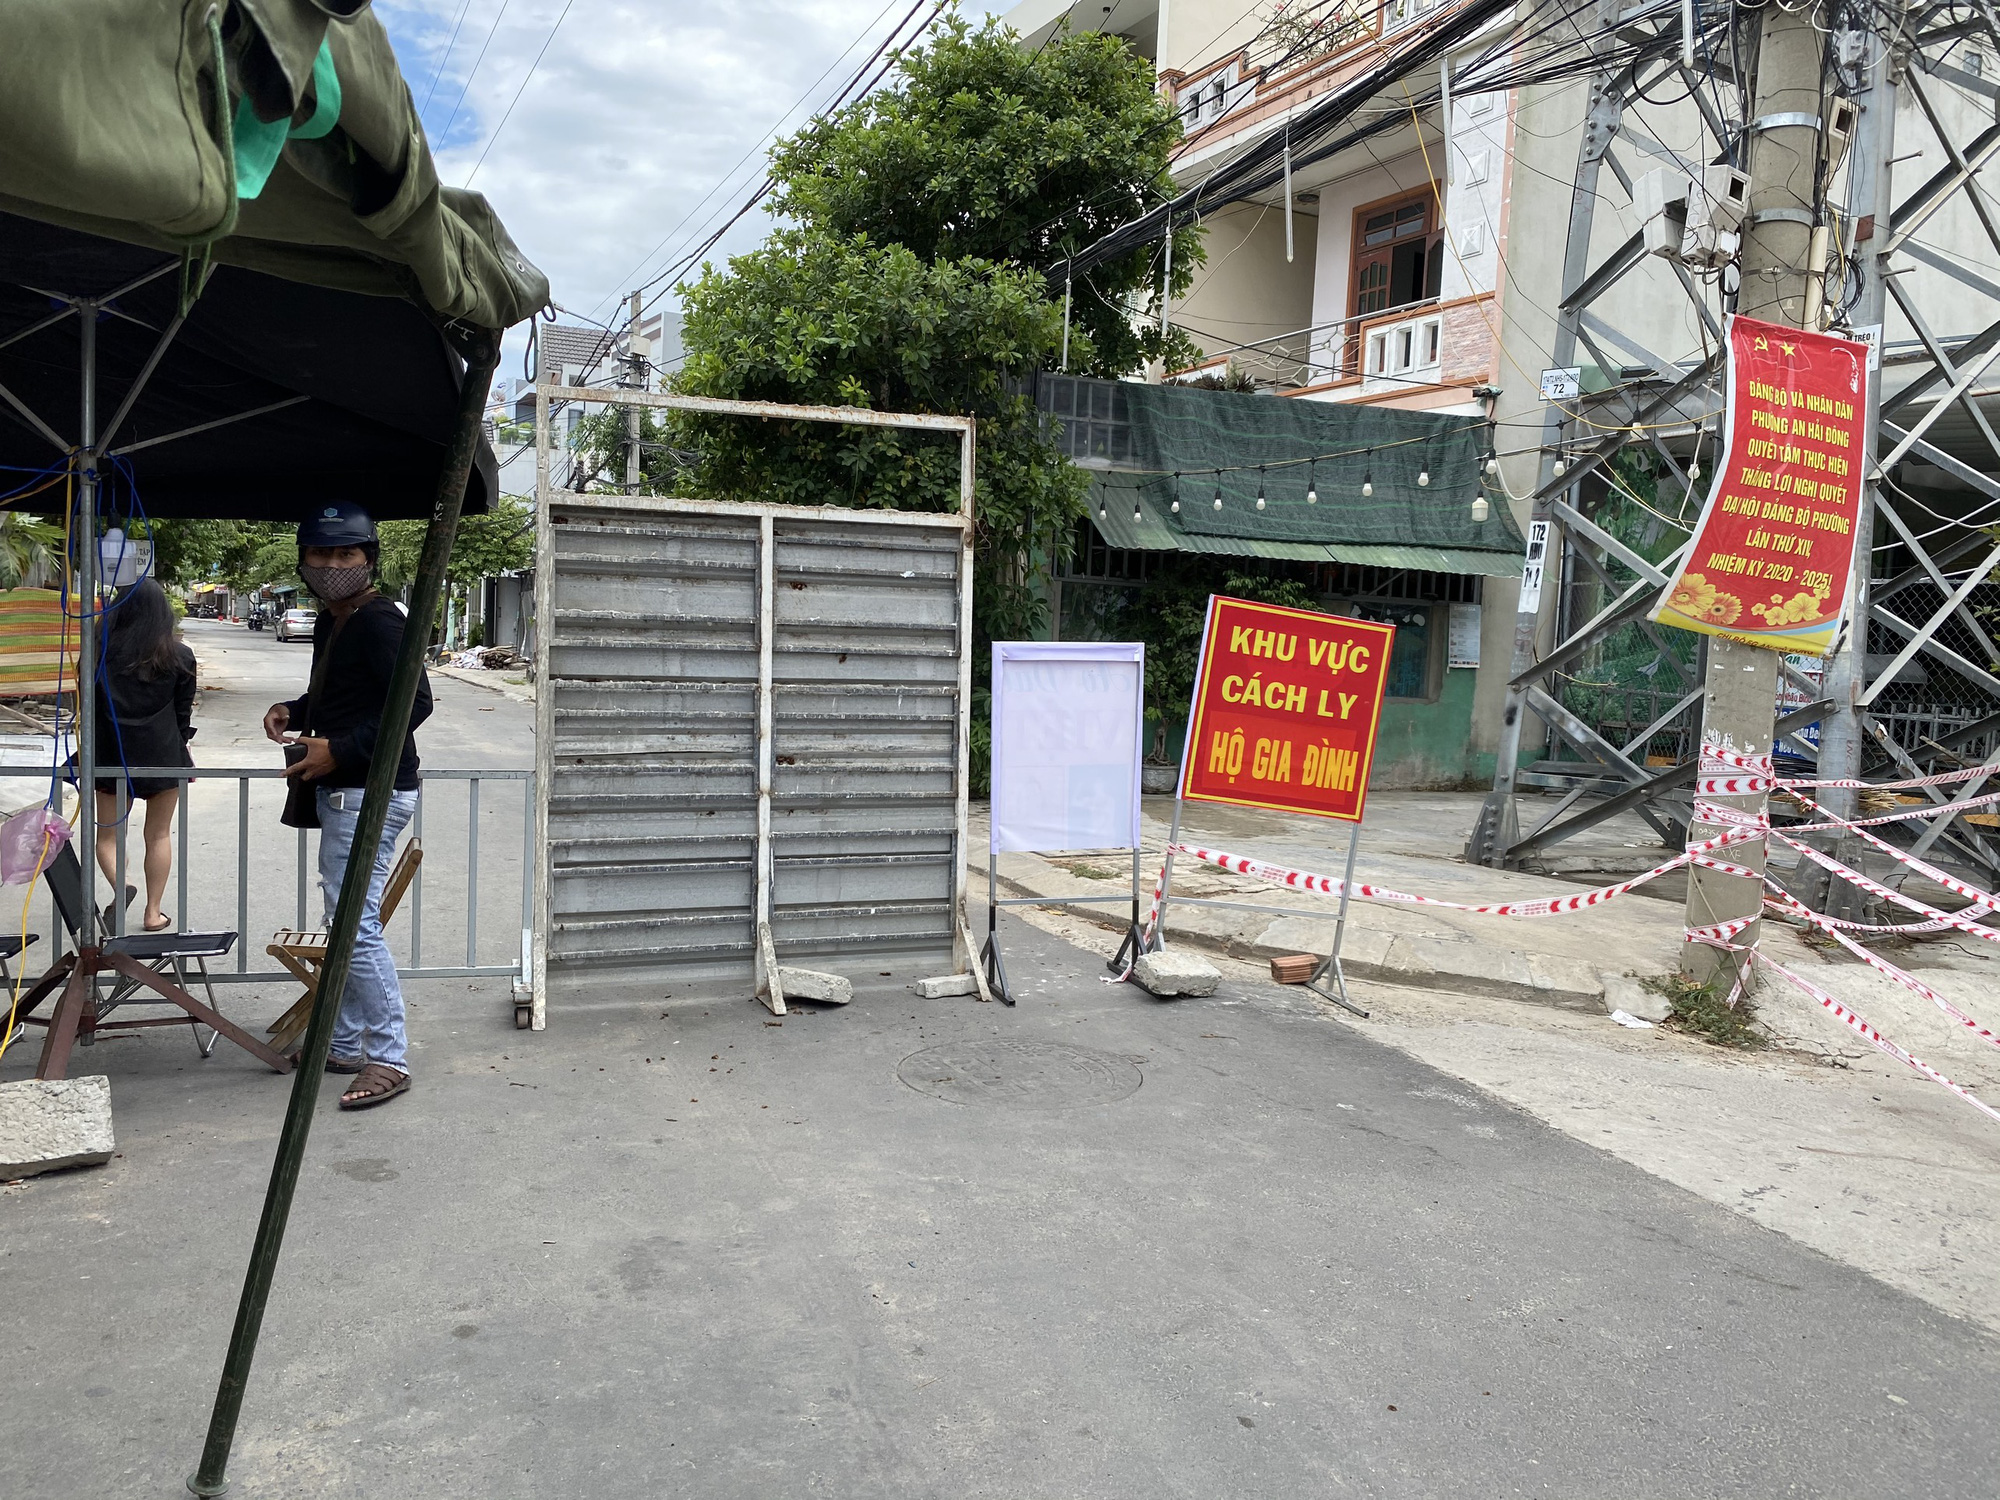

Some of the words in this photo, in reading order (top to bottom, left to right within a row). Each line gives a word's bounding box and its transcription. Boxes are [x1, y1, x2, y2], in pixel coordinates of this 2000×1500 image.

[1553, 384, 1565, 394] 72
[1749, 377, 1774, 402] ĐẢNG
[1774, 387, 1787, 409] BỘ
[1790, 388, 1805, 408] VÀ
[1806, 394, 1833, 415] NHÂN
[1835, 400, 1853, 421] DÂN
[1791, 418, 1806, 437] AN
[1807, 418, 1824, 441] HẢI
[1825, 425, 1849, 448] ĐÔNG
[1779, 443, 1801, 465] TÂM
[1803, 449, 1826, 473] THỰC
[1828, 454, 1848, 478] HIỆN
[1740, 463, 1772, 489] THẮNG
[1774, 473, 1792, 495] LỢI
[1793, 477, 1818, 502] NGHỊ
[1819, 482, 1847, 505] QUYẾT
[1532, 524, 1546, 541] 172
[1722, 495, 1742, 516] ĐẠI
[1740, 496, 1761, 520] HỘI
[1761, 498, 1794, 523] ĐẢNG
[1795, 505, 1811, 530] BỘ
[1811, 510, 1850, 535] PHƯỜNG
[1745, 525, 1770, 549] LẦN
[1771, 533, 1796, 553] THỨ
[1706, 552, 1747, 576] NHIỆM
[1746, 557, 1765, 577] KỲ
[1763, 563, 1794, 582] 2020
[1229, 625, 1298, 662] KHU
[1308, 638, 1370, 675] VỰC
[1221, 671, 1308, 713] CÁCH
[1317, 689, 1359, 720] LY
[1208, 726, 1246, 784] HỘ
[1251, 737, 1293, 783] GIA
[1301, 737, 1359, 792] ĐÌNH
